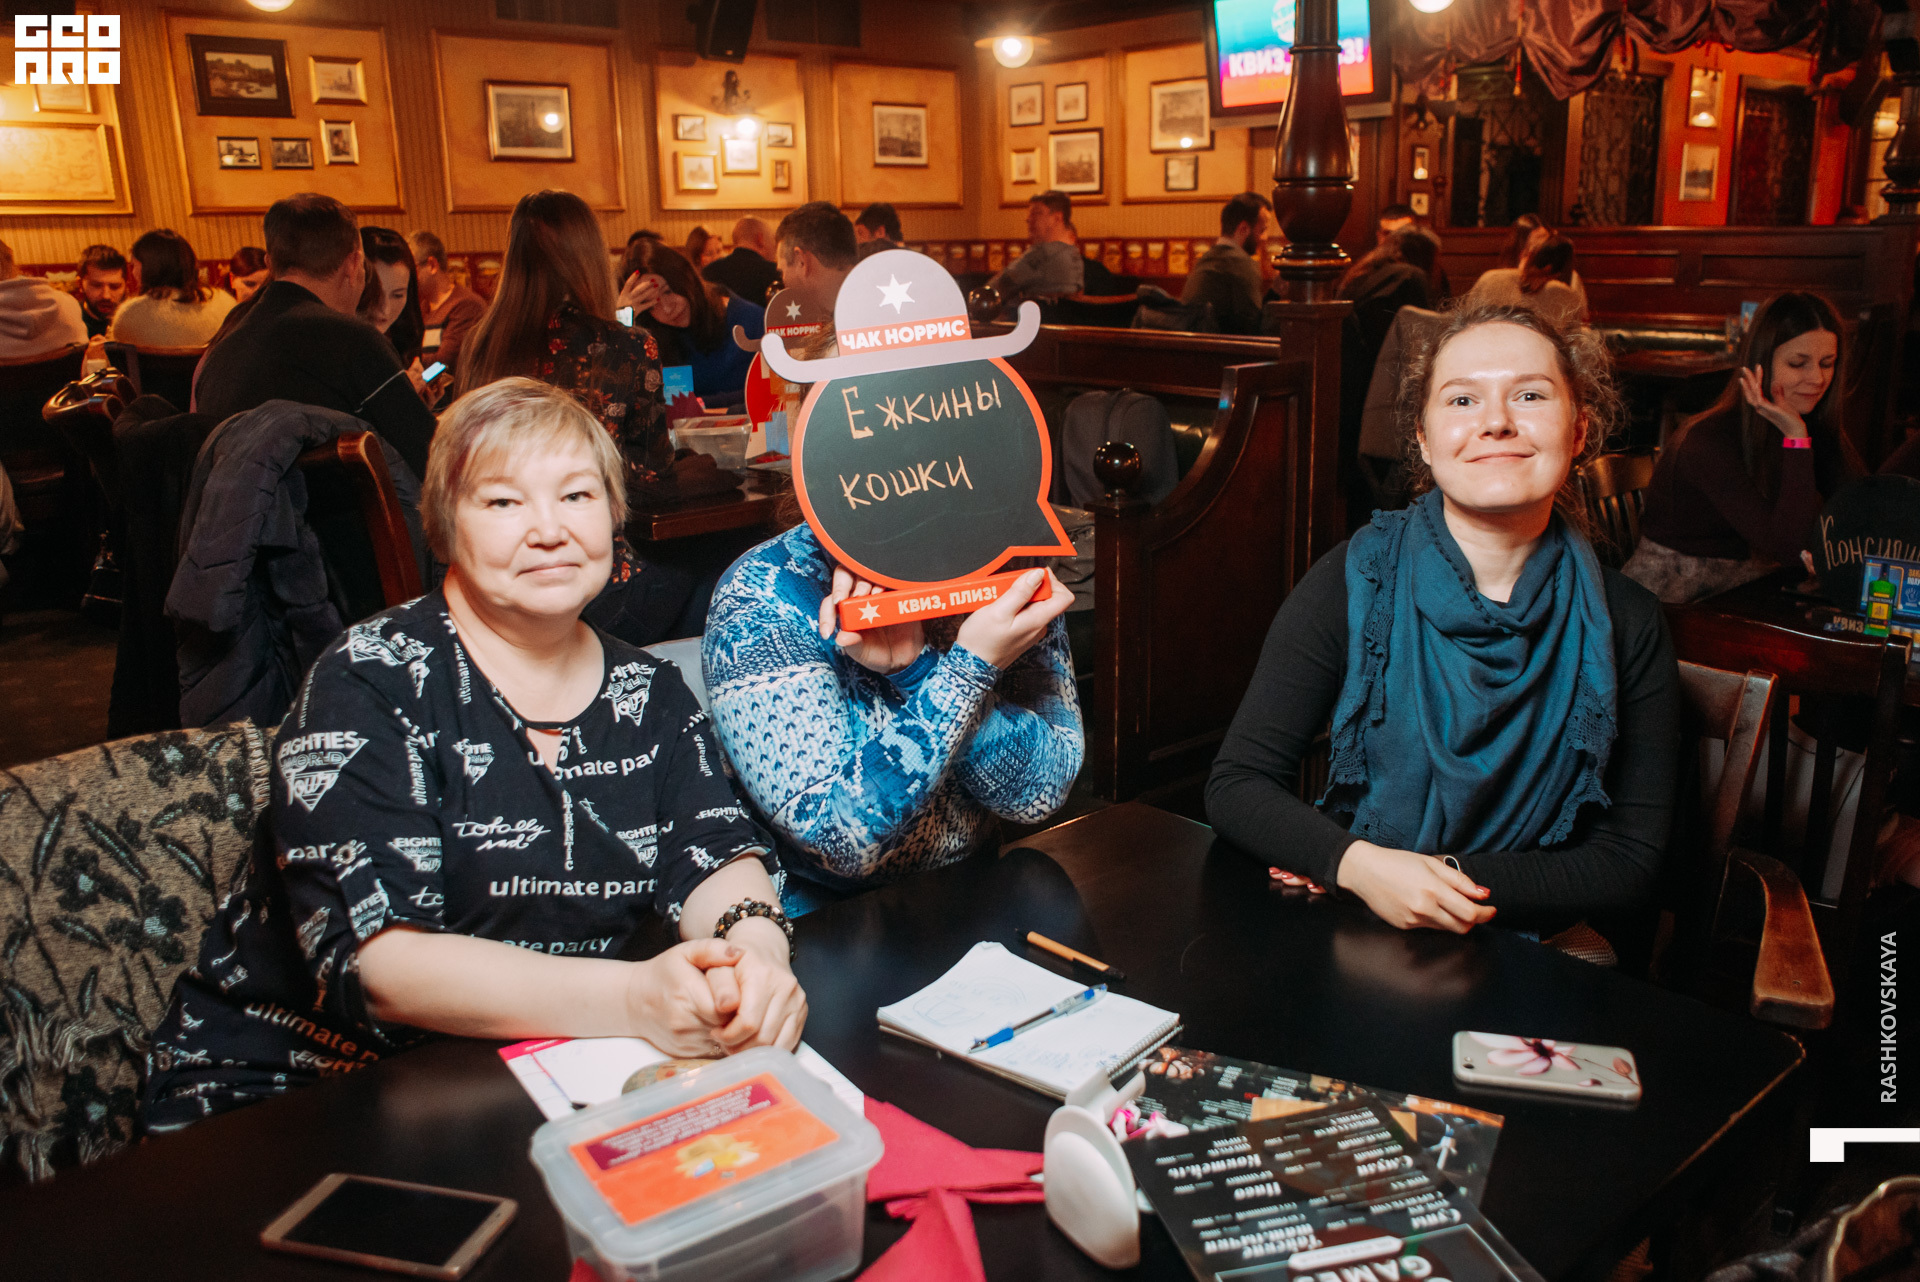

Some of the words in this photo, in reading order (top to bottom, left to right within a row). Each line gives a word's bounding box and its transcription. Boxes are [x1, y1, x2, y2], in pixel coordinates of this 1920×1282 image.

[841, 331, 883, 350] ЧАК
[885, 319, 966, 345] НОРРИС
[898, 595, 946, 615] КВИЗ,
[949, 586, 998, 606] ПЛИЗ!
[280, 731, 360, 758] EIGHTIES
[452, 816, 552, 842] totally
[489, 876, 599, 897] ultimate
[604, 878, 658, 900] part
[550, 937, 613, 956] party
[244, 1002, 358, 1057] ultimate
